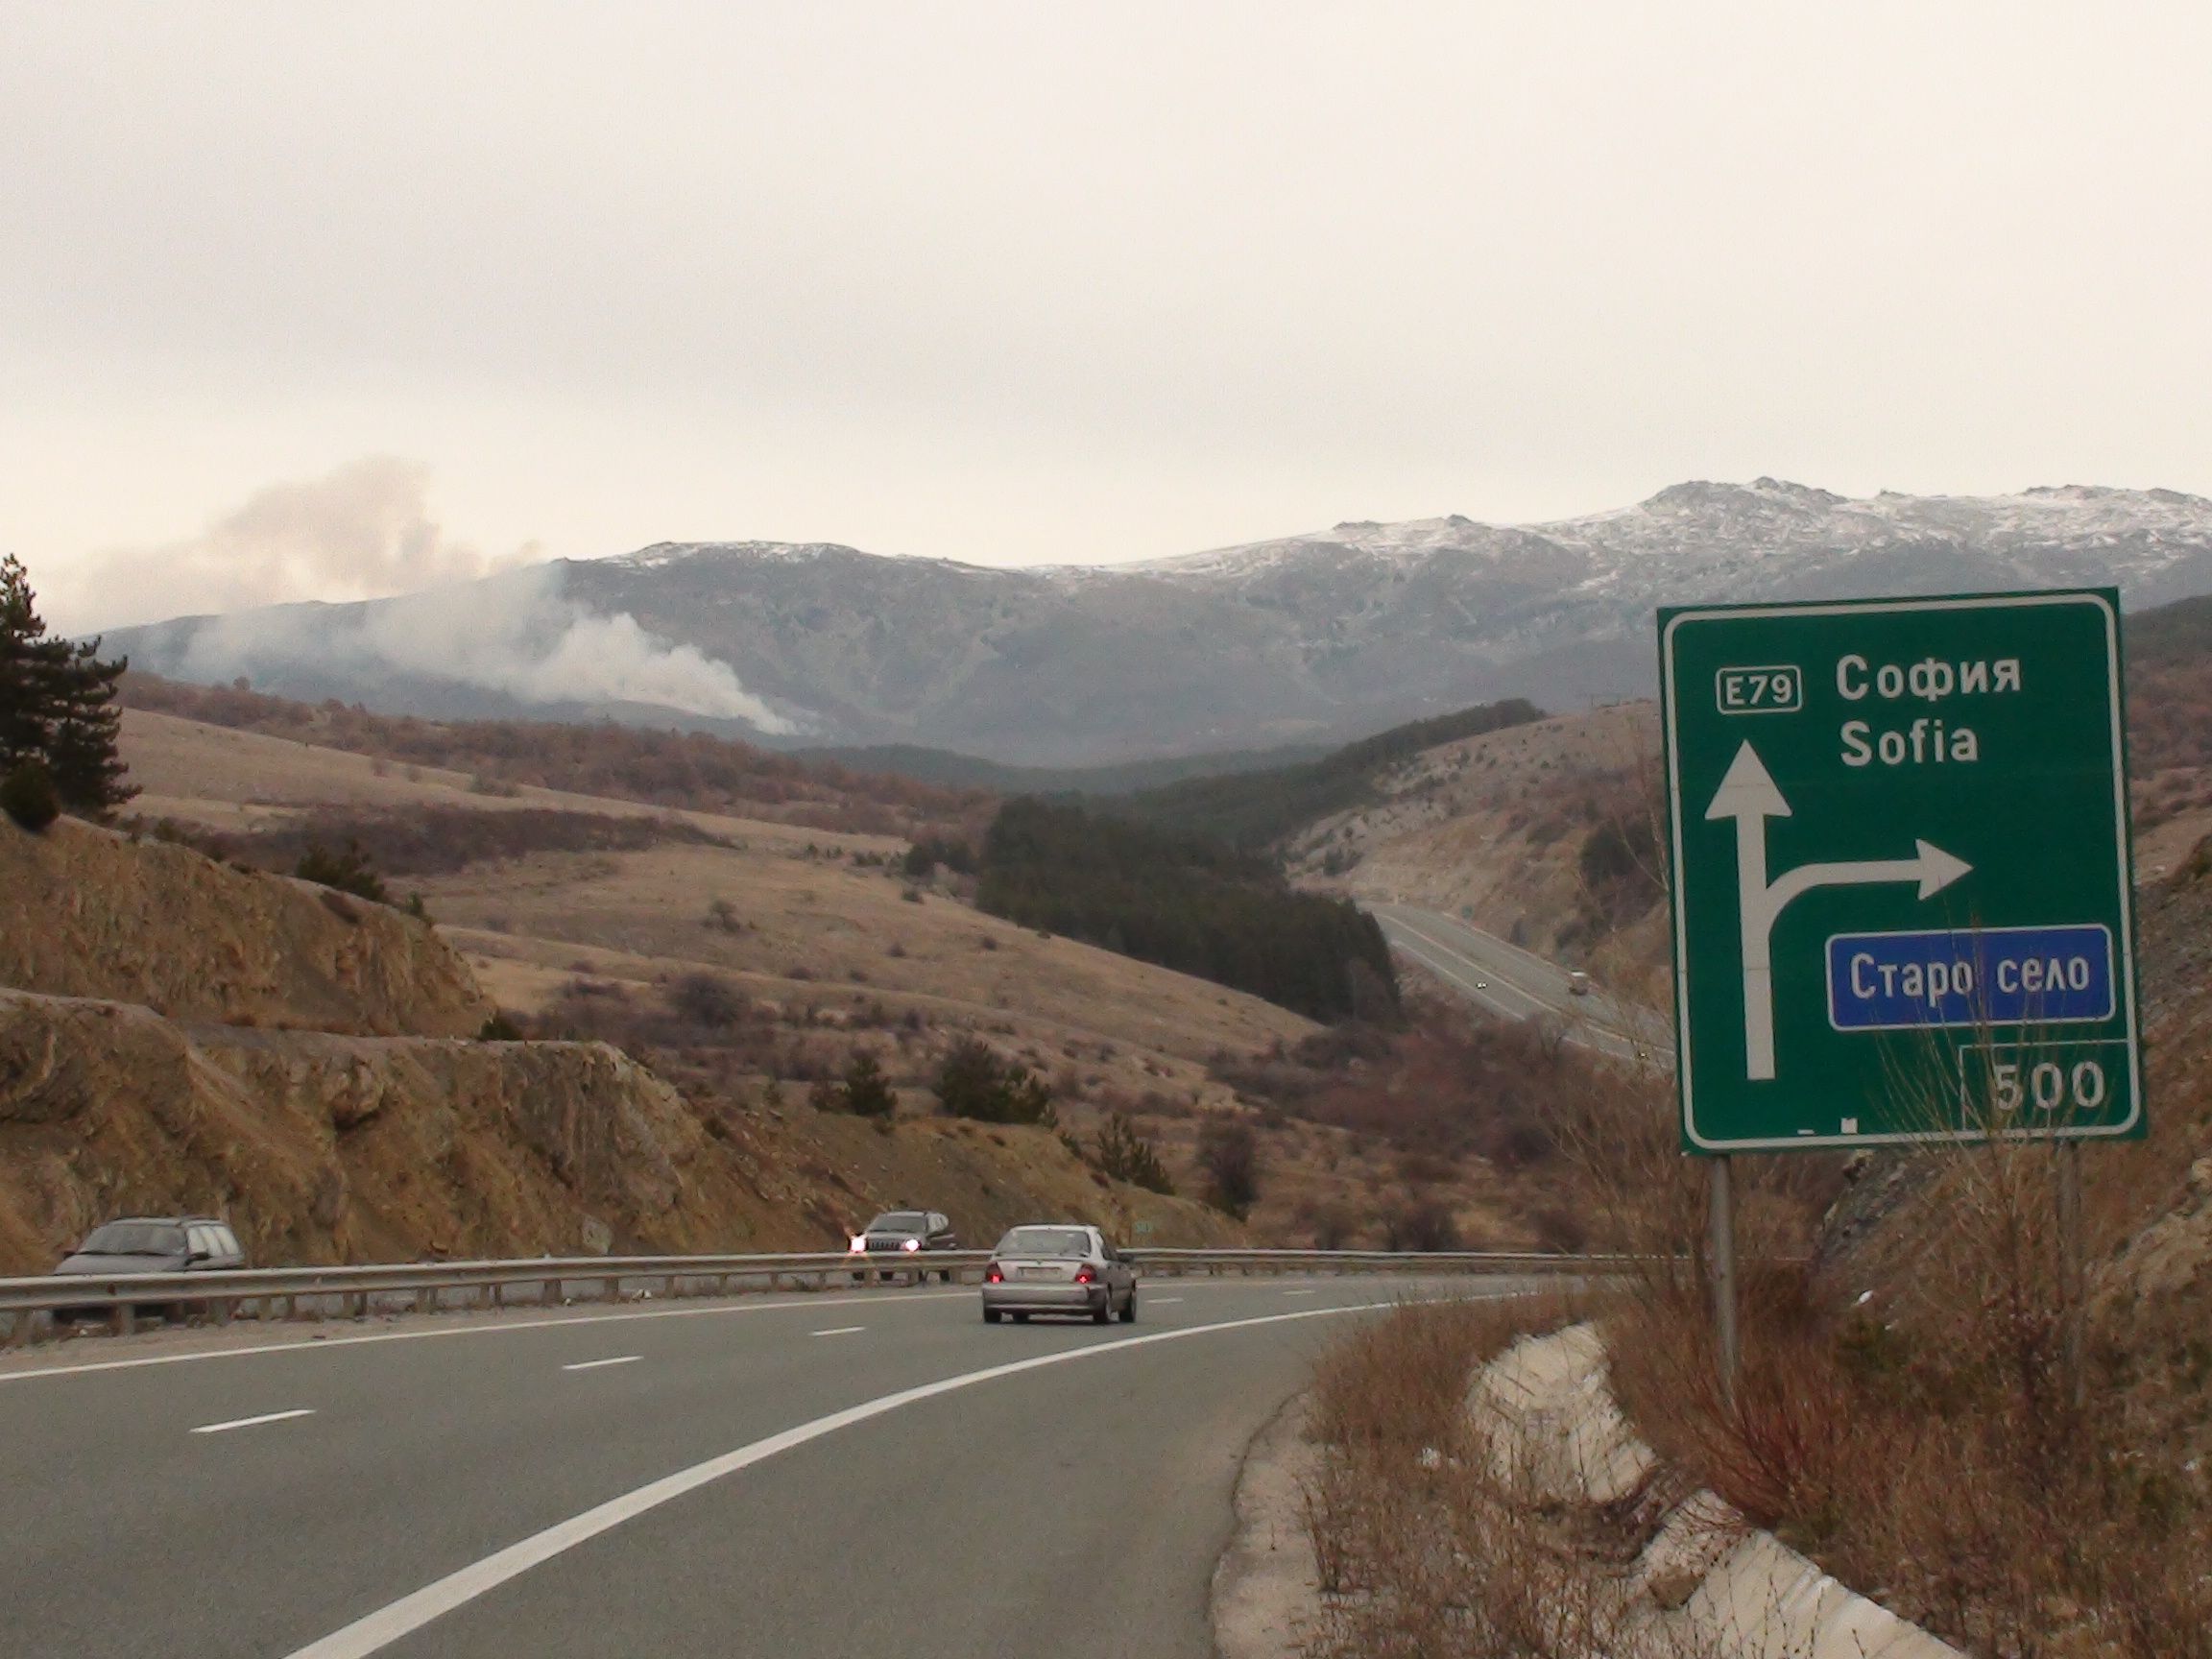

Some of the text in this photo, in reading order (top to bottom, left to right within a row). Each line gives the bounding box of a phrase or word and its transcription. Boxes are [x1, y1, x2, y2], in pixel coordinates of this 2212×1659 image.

[1725, 674, 1793, 707] E79
[1836, 654, 2022, 702] София
[1839, 718, 1980, 767] Sofia
[1849, 951, 2090, 1008] Старо село
[1993, 1060, 2105, 1110] 500
